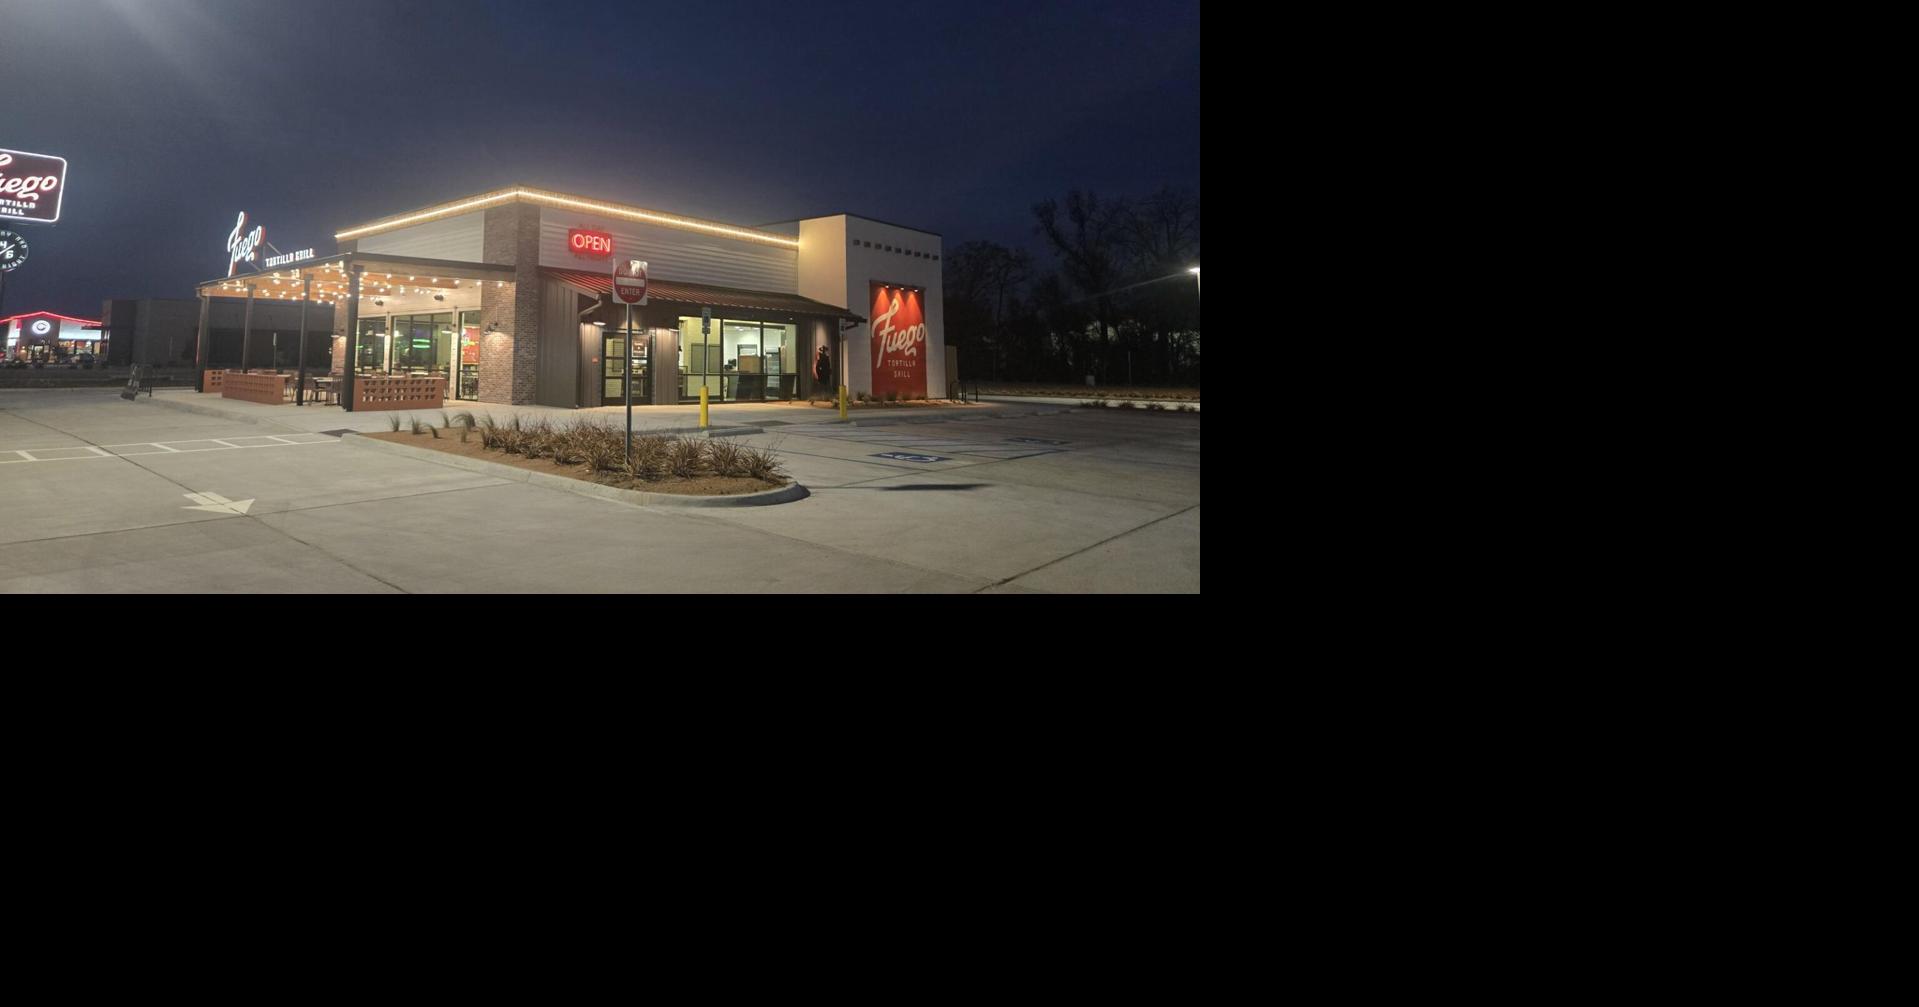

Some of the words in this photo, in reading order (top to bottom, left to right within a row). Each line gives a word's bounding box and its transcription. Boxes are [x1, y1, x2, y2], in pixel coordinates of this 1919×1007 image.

[1, 207, 25, 216] RILL
[227, 211, 263, 277] Fuego
[572, 233, 611, 252] OPEN
[295, 248, 314, 261] GRILL
[620, 287, 641, 296] ENTER
[872, 298, 925, 368] Fuego
